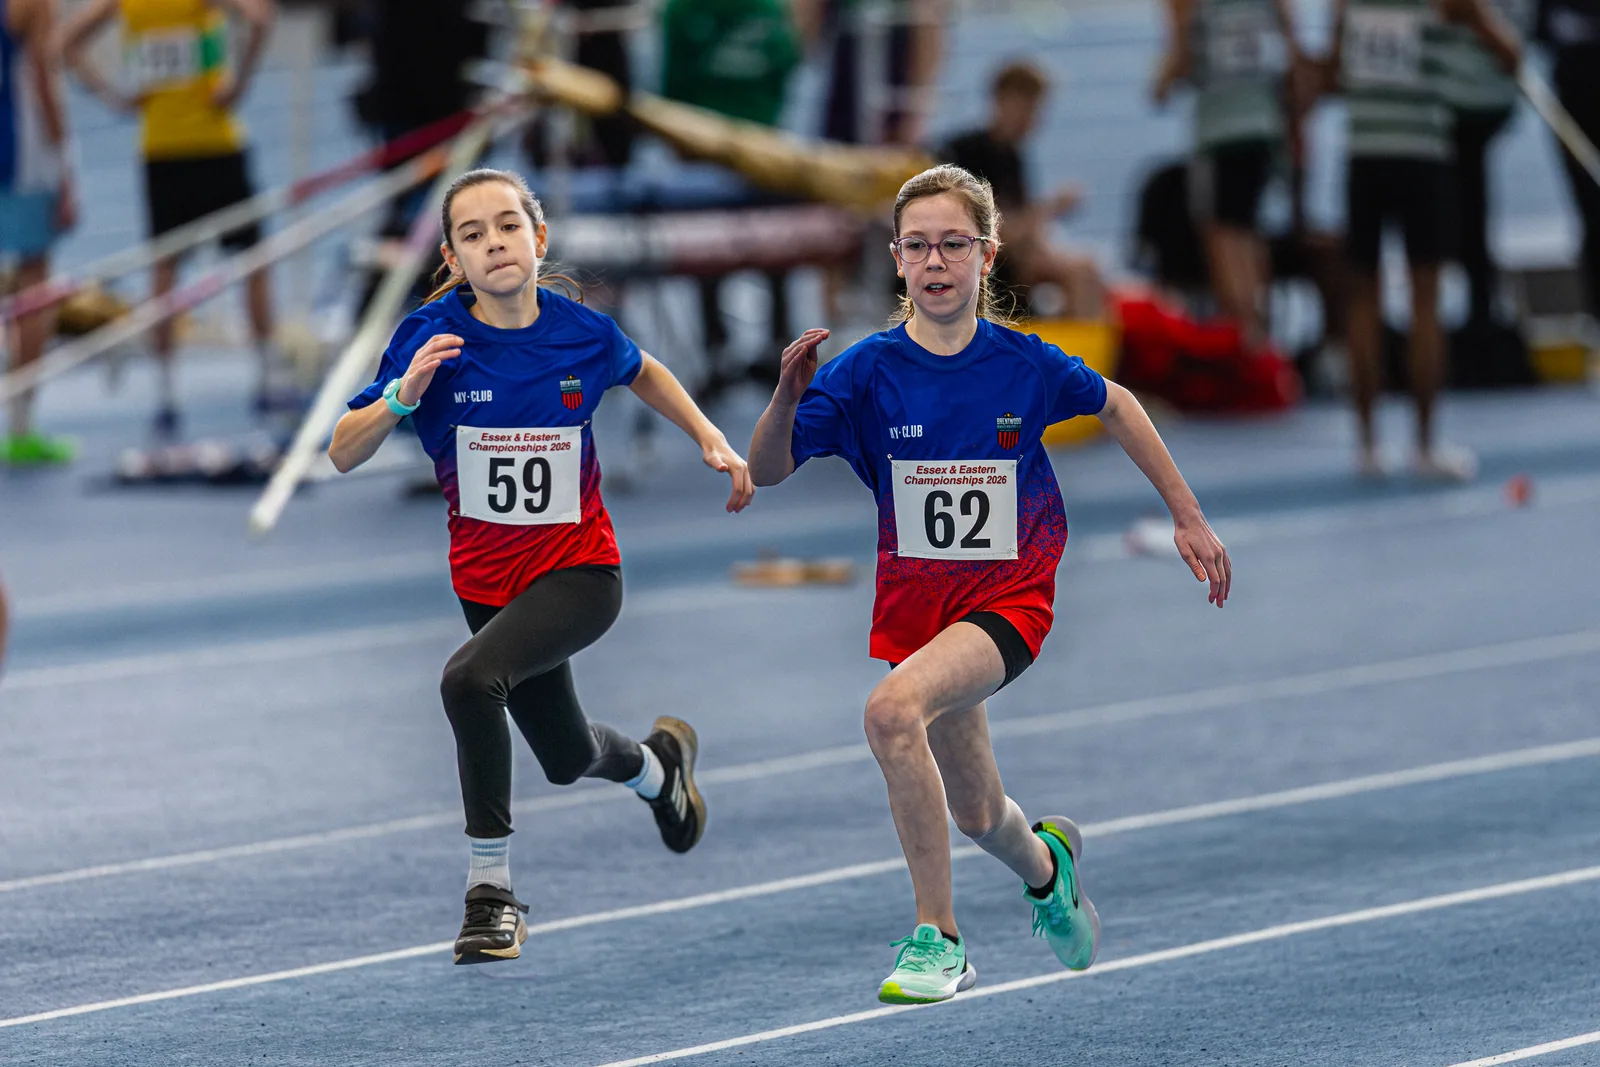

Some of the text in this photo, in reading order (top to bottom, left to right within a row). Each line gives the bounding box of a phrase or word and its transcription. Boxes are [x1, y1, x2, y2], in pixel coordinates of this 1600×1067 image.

[481, 433, 560, 442] Essex & Eastern
[468, 441, 571, 453] Championships 2026
[916, 465, 996, 474] Essex & Eastern
[487, 457, 552, 514] 59
[904, 475, 1007, 486] Championships 2026
[924, 490, 991, 549] 62
